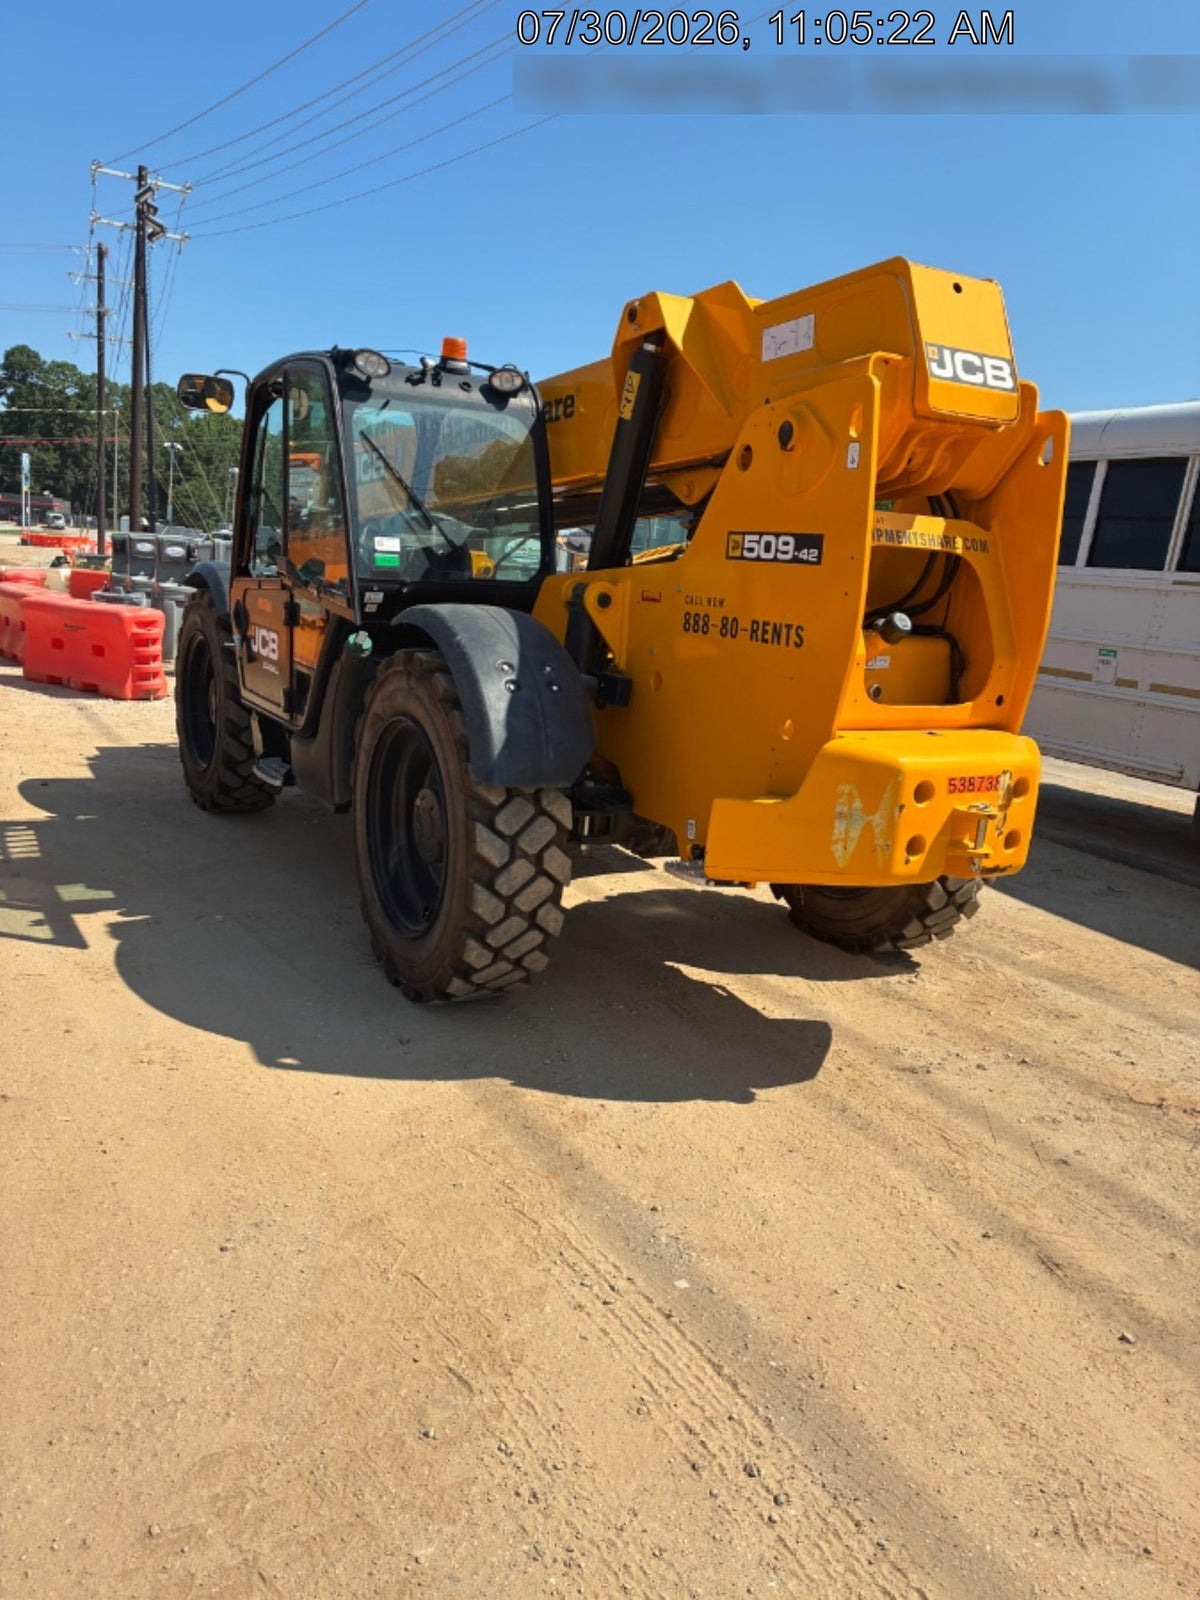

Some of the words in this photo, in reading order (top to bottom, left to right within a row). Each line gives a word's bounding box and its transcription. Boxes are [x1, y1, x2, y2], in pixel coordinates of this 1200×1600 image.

[929, 347, 1014, 389] JCB
[251, 625, 279, 661] JCB
[682, 611, 806, 649] 888-80-RENTS
